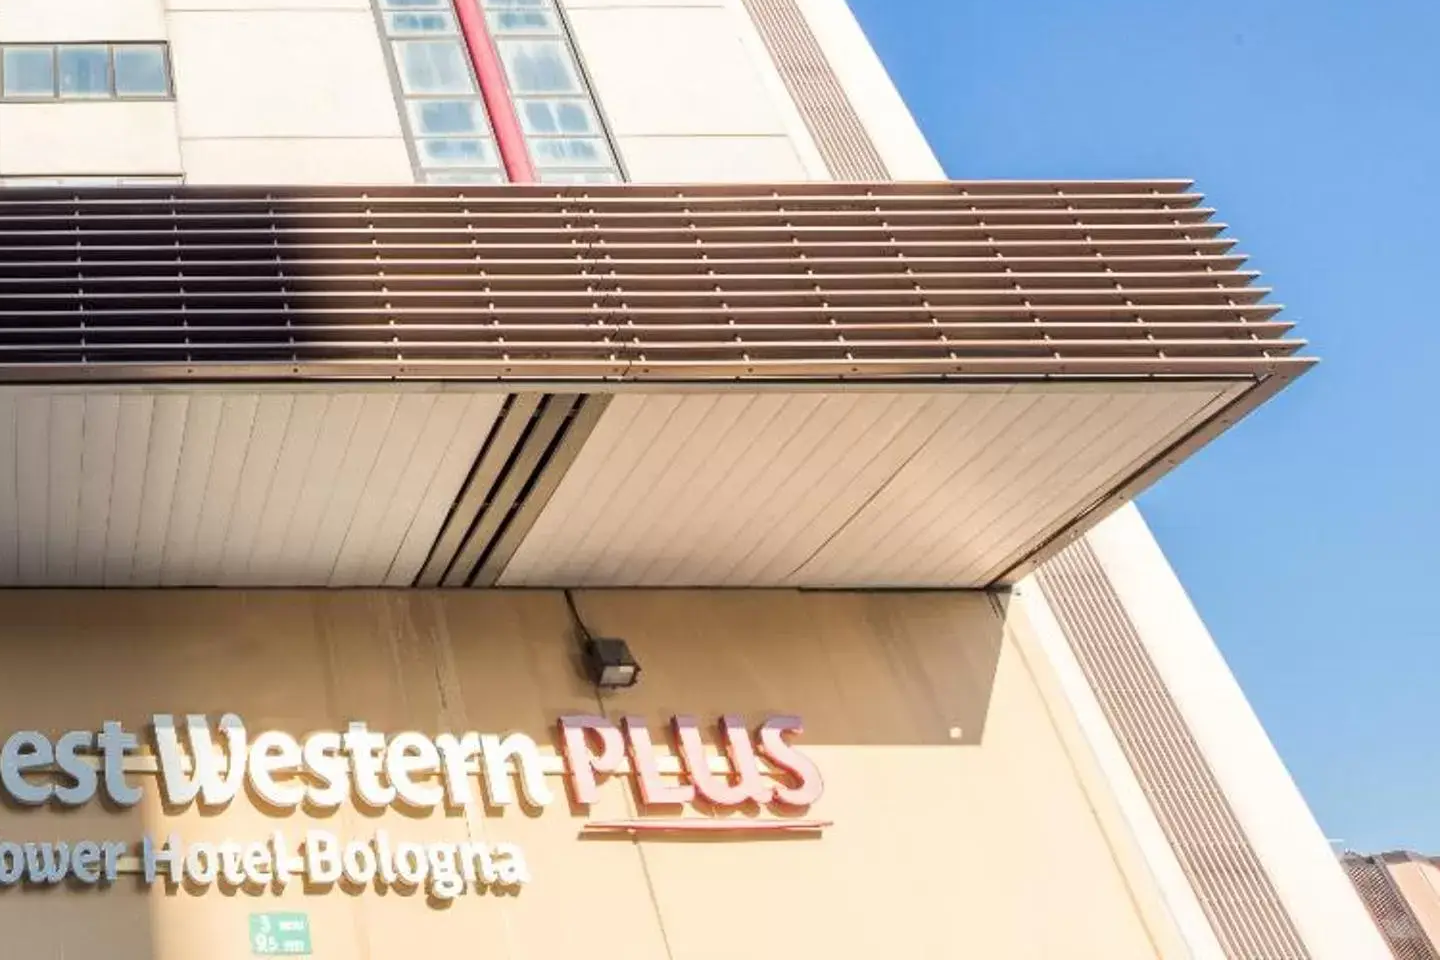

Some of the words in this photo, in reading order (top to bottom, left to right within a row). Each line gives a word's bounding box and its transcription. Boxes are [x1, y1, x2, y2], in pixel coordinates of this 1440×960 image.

[152, 713, 555, 808] Western
[558, 714, 824, 806] PLUS
[143, 830, 290, 885] Hotel
[303, 830, 530, 899] Bologna
